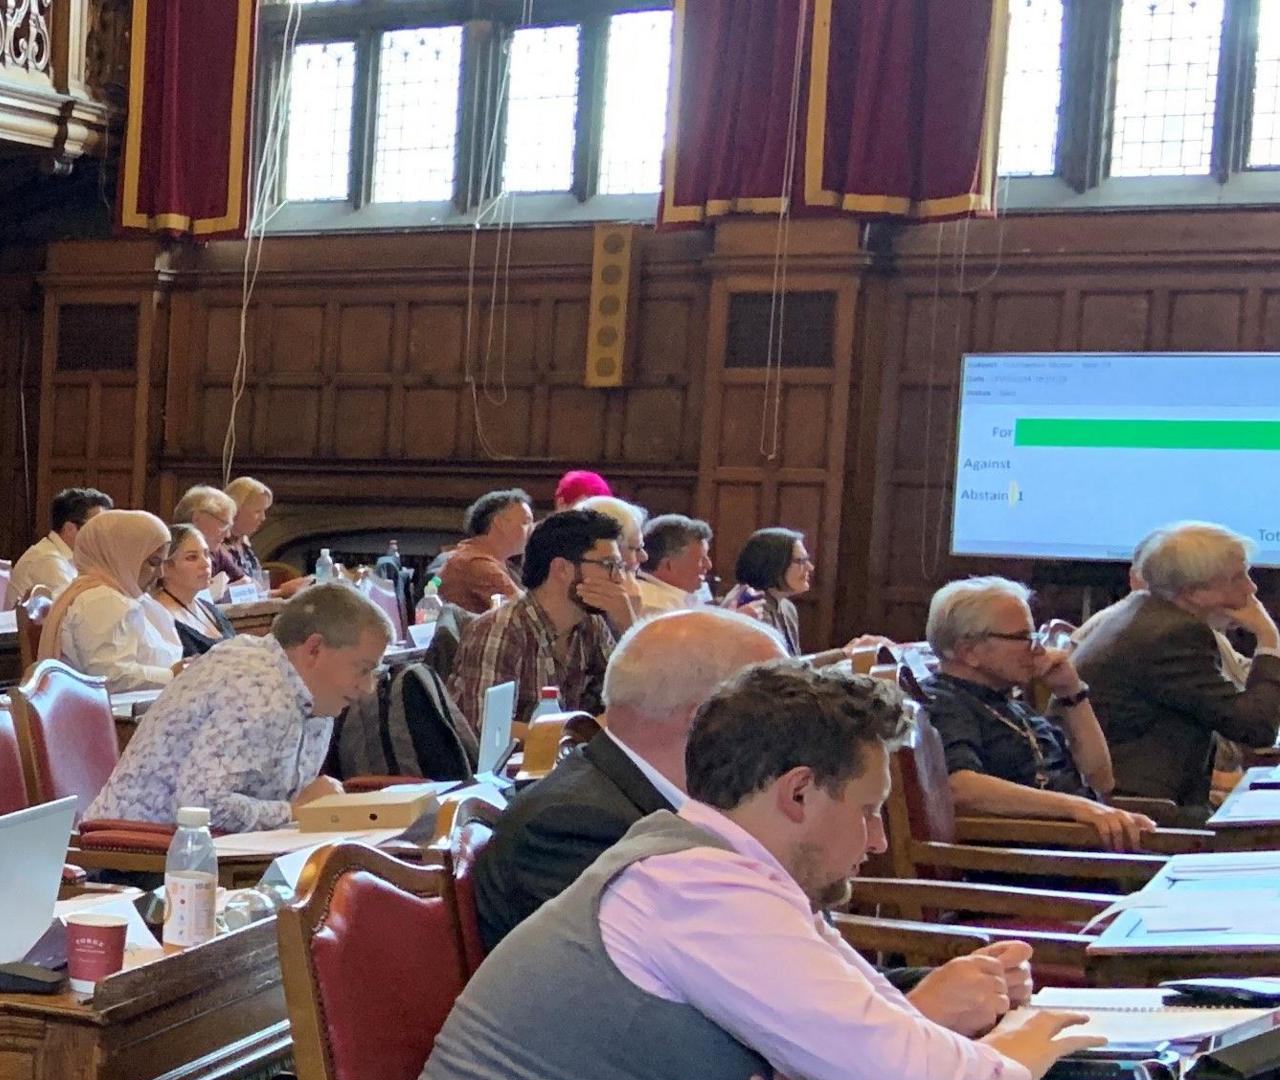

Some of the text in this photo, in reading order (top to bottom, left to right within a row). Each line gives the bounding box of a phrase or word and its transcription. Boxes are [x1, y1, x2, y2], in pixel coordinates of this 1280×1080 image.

[992, 427, 1013, 438] For
[963, 458, 1011, 471] Against
[960, 489, 1024, 501] Abstain 1
